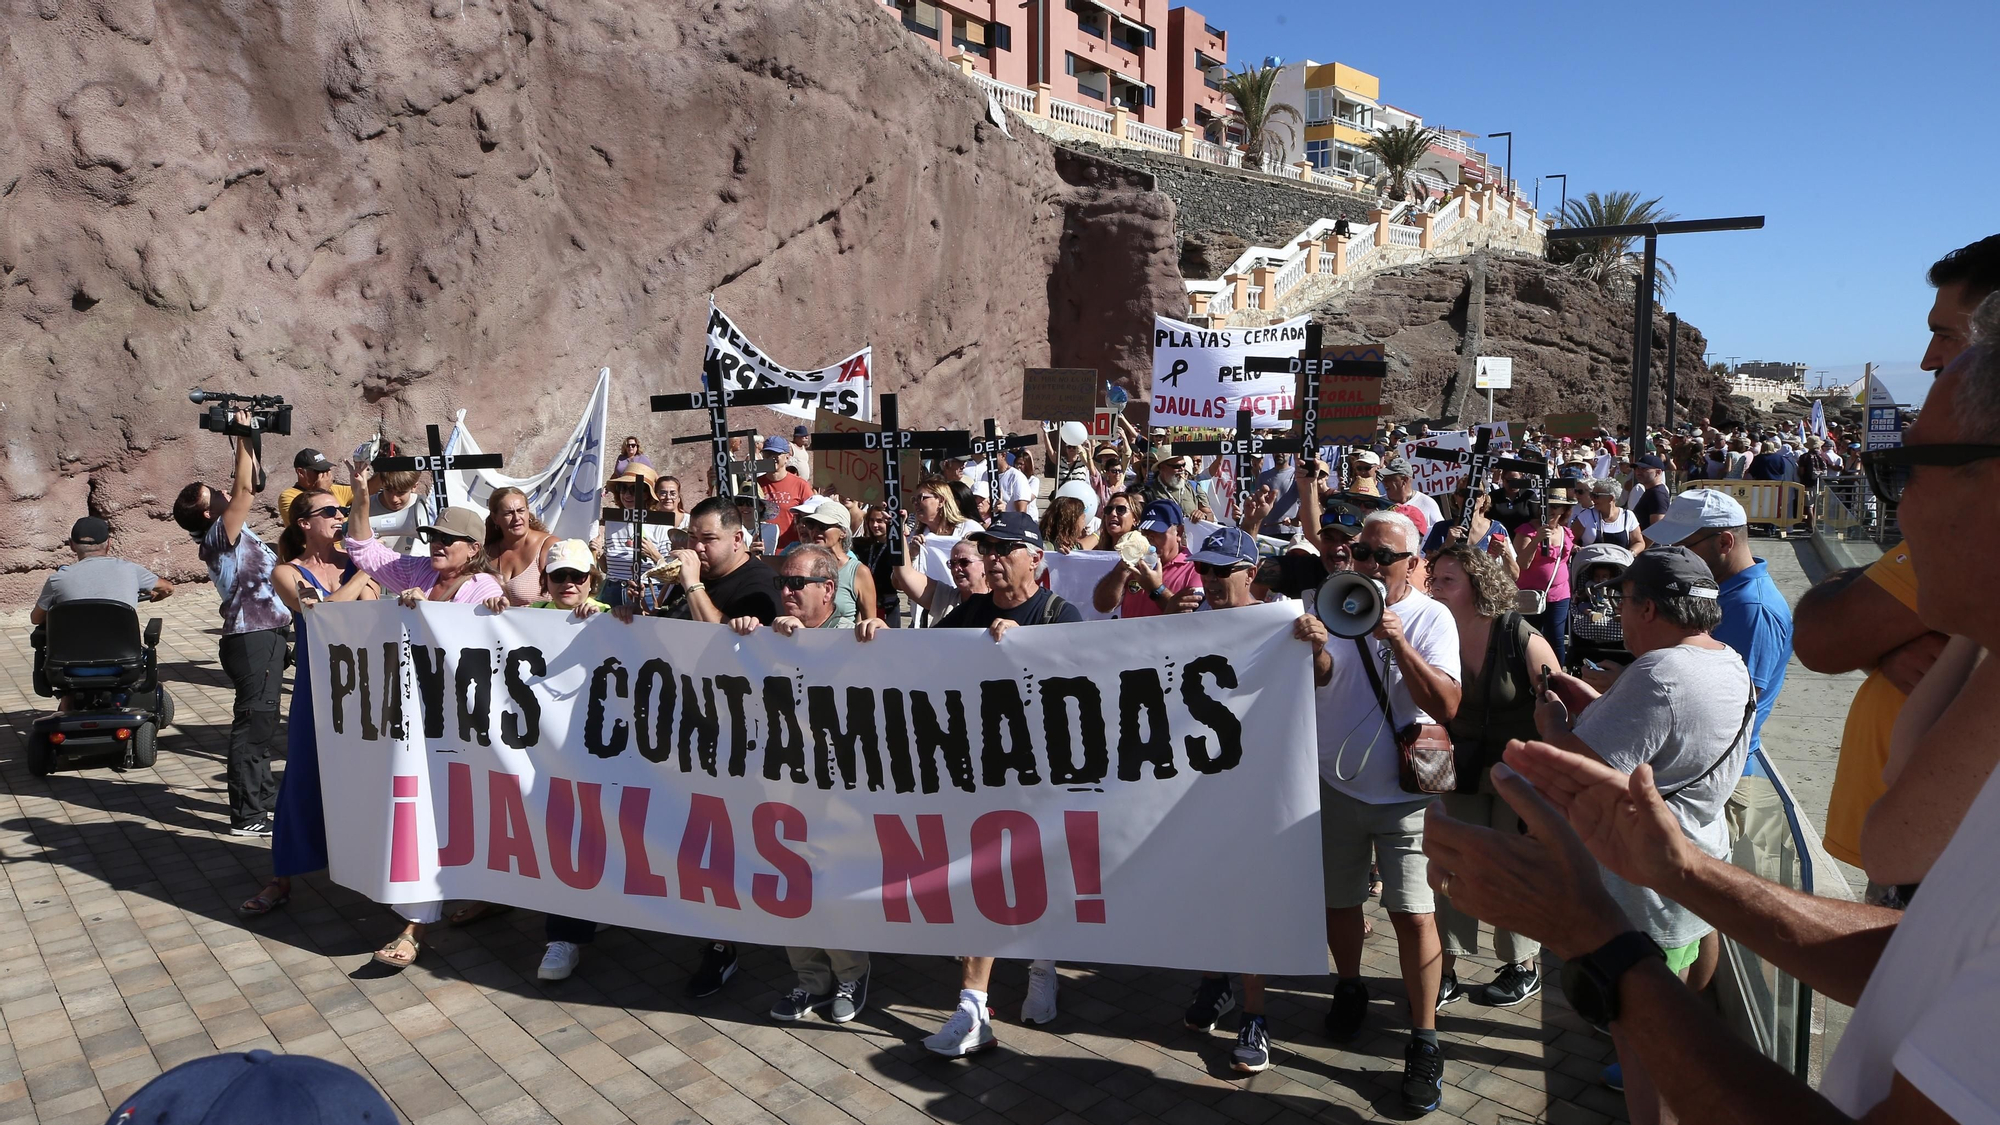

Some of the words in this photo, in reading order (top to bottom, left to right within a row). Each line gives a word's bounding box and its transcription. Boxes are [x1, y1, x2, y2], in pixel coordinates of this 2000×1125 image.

[1155, 329, 1231, 348] PLAYAS
[704, 345, 859, 416] URGETES
[838, 355, 869, 382] YA
[1154, 395, 1227, 418] JAULAS
[1238, 395, 1294, 417] ACTIV
[1293, 405, 1383, 419] CTAMINADO
[1303, 374, 1319, 460] LITORAL
[1319, 390, 1365, 402] TORAL
[713, 408, 730, 497] LITORA
[743, 461, 757, 472] SOS
[826, 448, 912, 492] LITORL
[1412, 461, 1462, 479] PLAYA
[885, 449, 901, 555] LITORAL
[1460, 466, 1481, 531] LITORA
[328, 642, 547, 749] PLAYAS
[584, 655, 1243, 794] CONTAMINADAS
[389, 762, 813, 919] ¡JAULAS
[874, 809, 1106, 926] NO!
